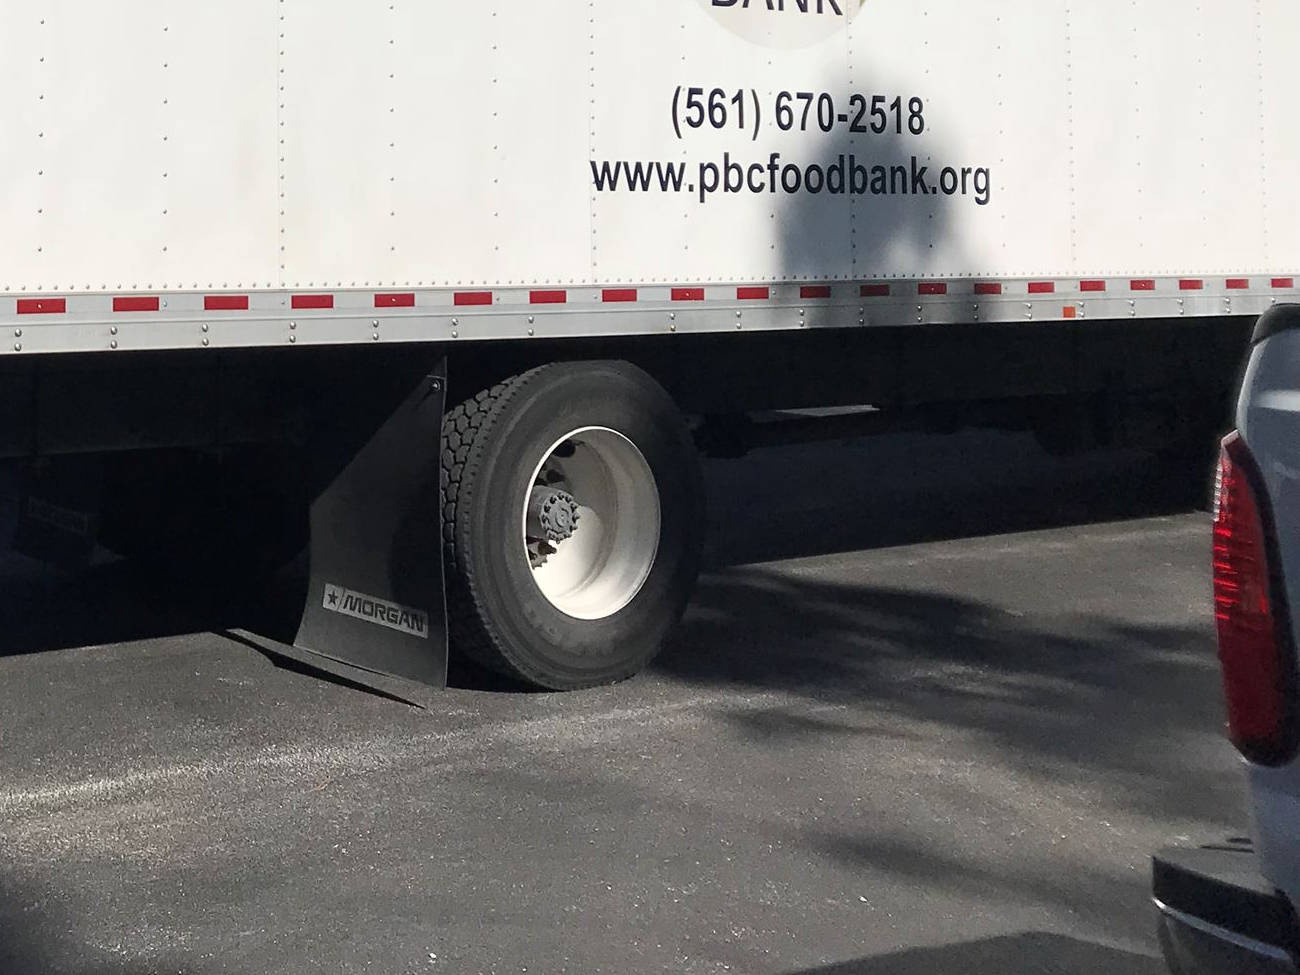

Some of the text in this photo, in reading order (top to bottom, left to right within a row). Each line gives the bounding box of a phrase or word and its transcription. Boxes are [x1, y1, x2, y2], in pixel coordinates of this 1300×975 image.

[672, 86, 925, 140] (561) 670-2518
[590, 153, 990, 205] www.pbcfoodbank.org
[342, 594, 425, 632] MORGAN
